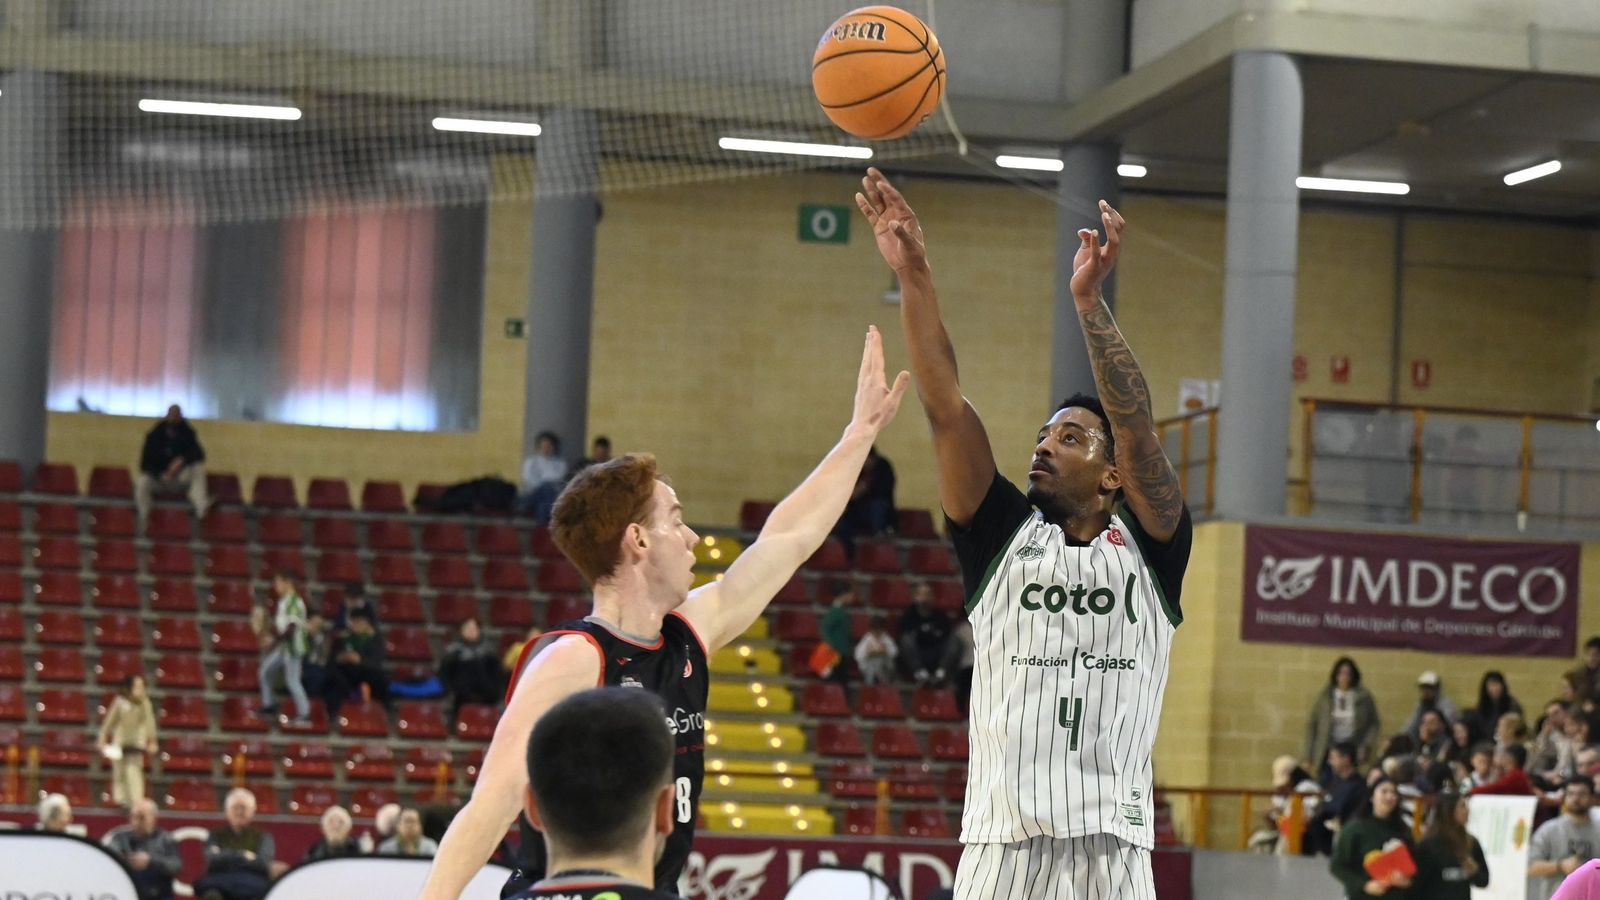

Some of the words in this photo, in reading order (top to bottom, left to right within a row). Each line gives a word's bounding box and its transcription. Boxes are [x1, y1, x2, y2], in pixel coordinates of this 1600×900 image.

[818, 22, 886, 48] Wils
[1329, 556, 1567, 613] IMDECO
[1323, 613, 1397, 632] Municipal
[1400, 618, 1419, 633] de
[1011, 655, 1068, 667] Fundación
[1082, 653, 1136, 673] Cajaso
[1059, 697, 1082, 751] 4
